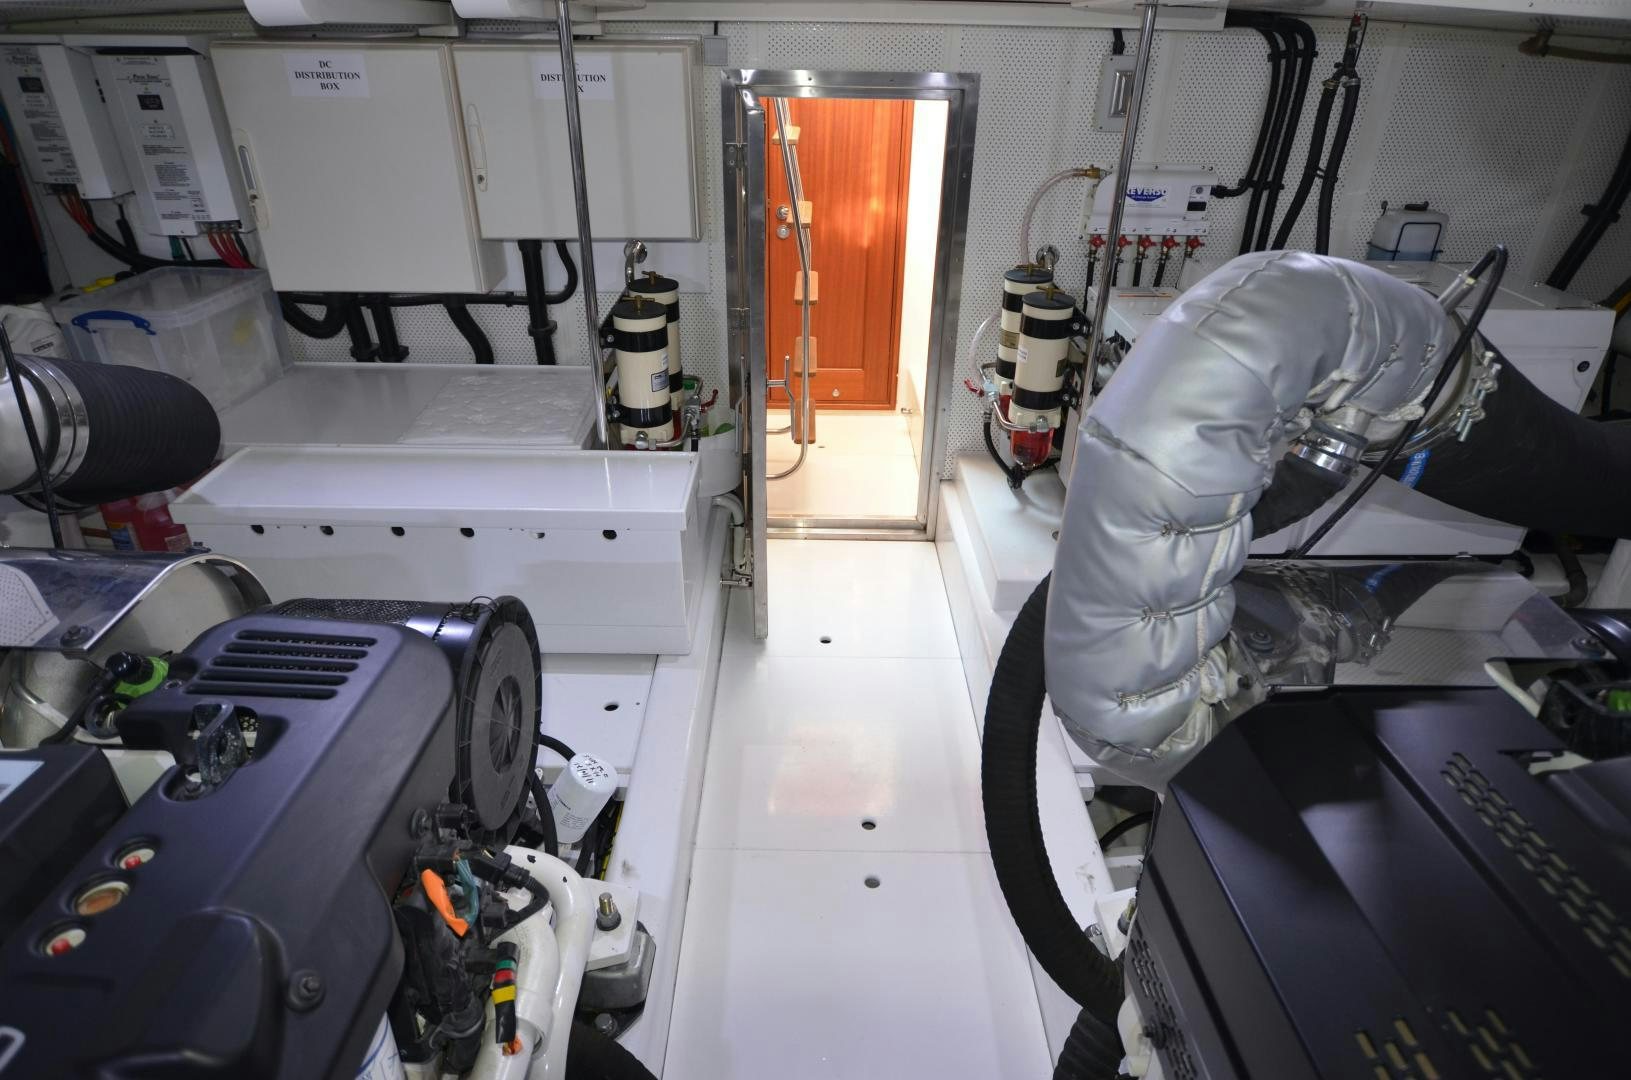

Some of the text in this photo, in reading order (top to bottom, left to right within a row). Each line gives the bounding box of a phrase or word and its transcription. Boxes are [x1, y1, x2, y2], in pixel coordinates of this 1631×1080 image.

[318, 60, 333, 69] DC
[294, 71, 361, 80] DISTRIBUTION
[540, 73, 607, 82] DISTUTION
[320, 82, 340, 91] BOX
